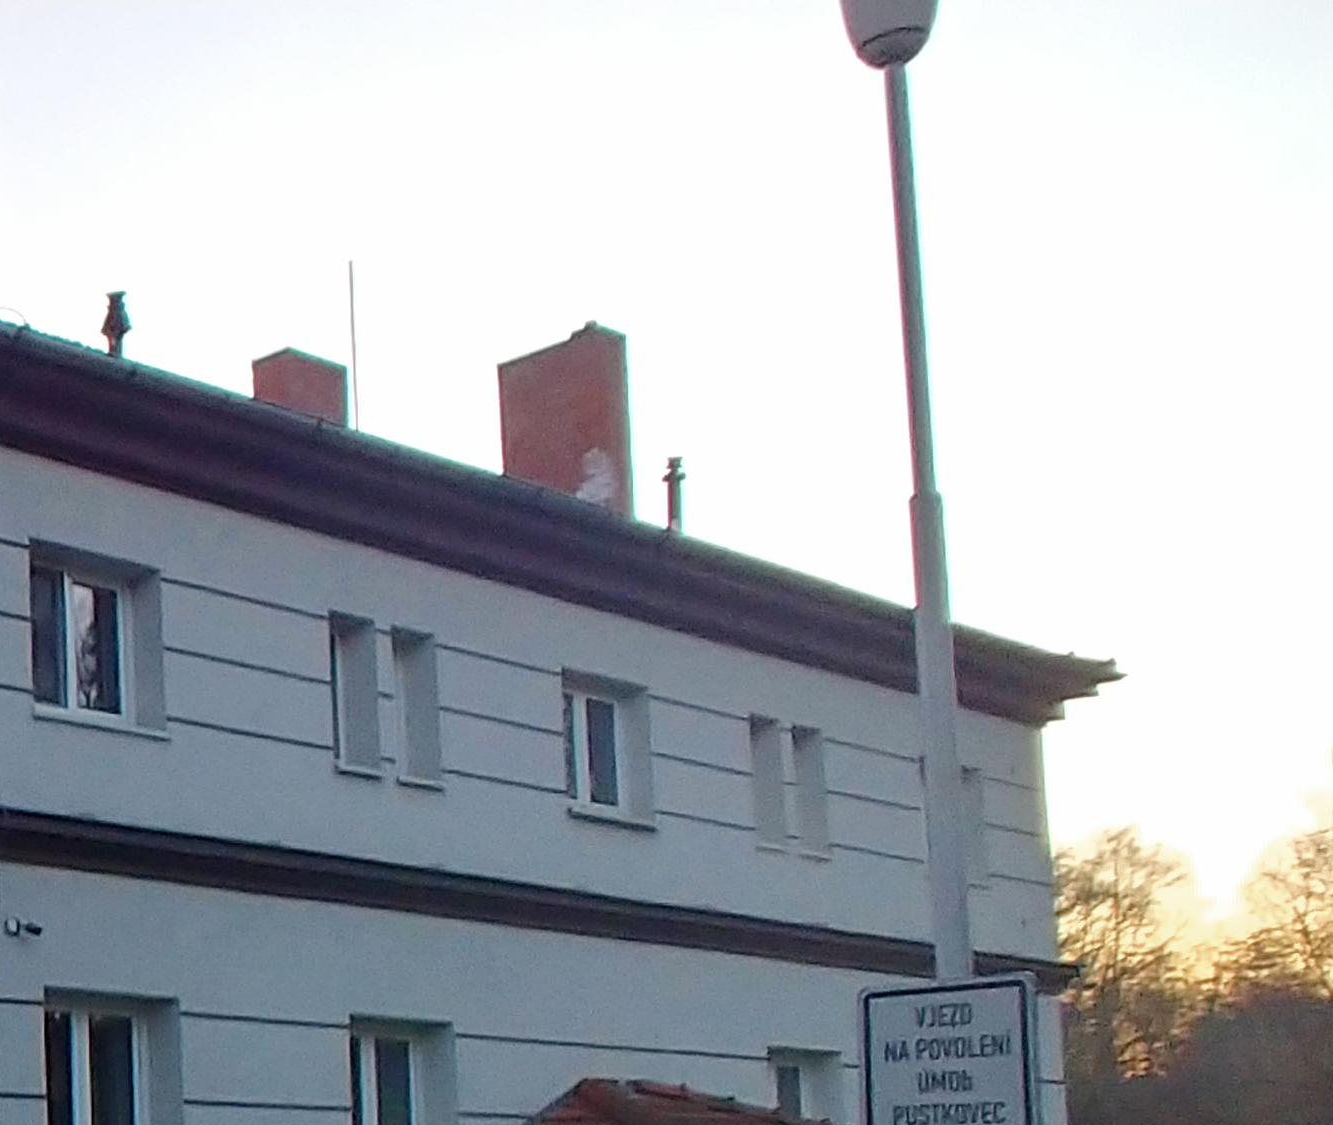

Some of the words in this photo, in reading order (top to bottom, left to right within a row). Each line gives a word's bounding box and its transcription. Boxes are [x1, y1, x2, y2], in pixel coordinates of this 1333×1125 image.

[915, 1003, 972, 1028] VJEZD
[884, 1040, 910, 1063] NA
[915, 1029, 1011, 1061] POVOLENÍ
